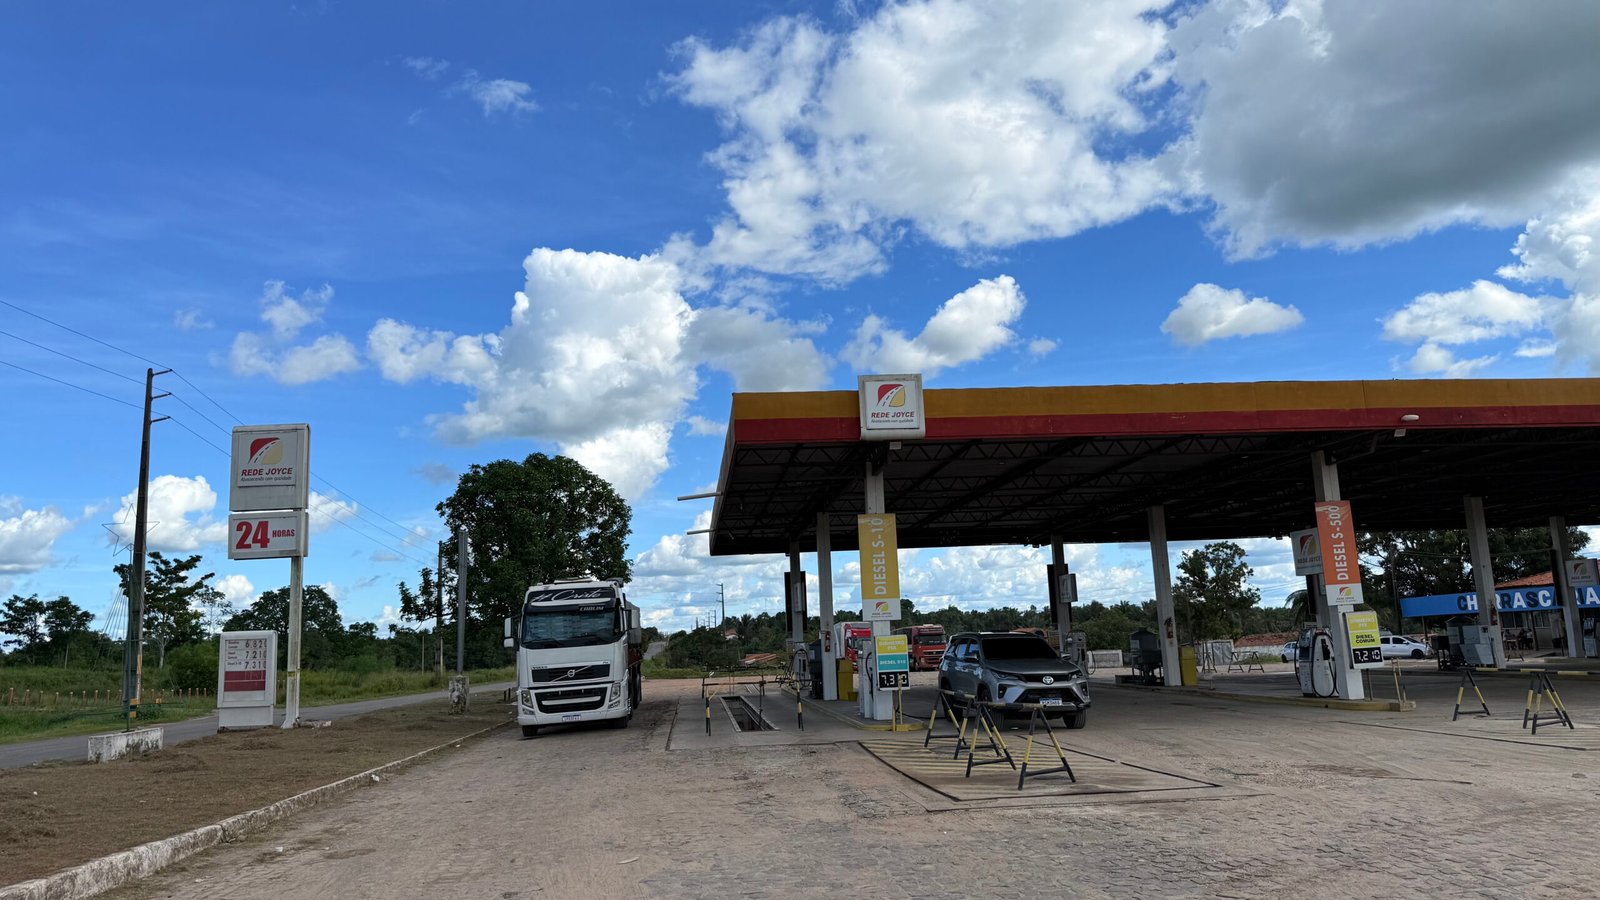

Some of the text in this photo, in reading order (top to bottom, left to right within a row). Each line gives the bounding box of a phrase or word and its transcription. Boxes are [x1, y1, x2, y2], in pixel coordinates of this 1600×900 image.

[265, 467, 293, 475] JOYCE
[236, 520, 296, 549] 24 HORAS
[1328, 505, 1344, 540] S-500
[871, 518, 887, 595] DIESEL S-10
[1333, 541, 1349, 581] DIESEL
